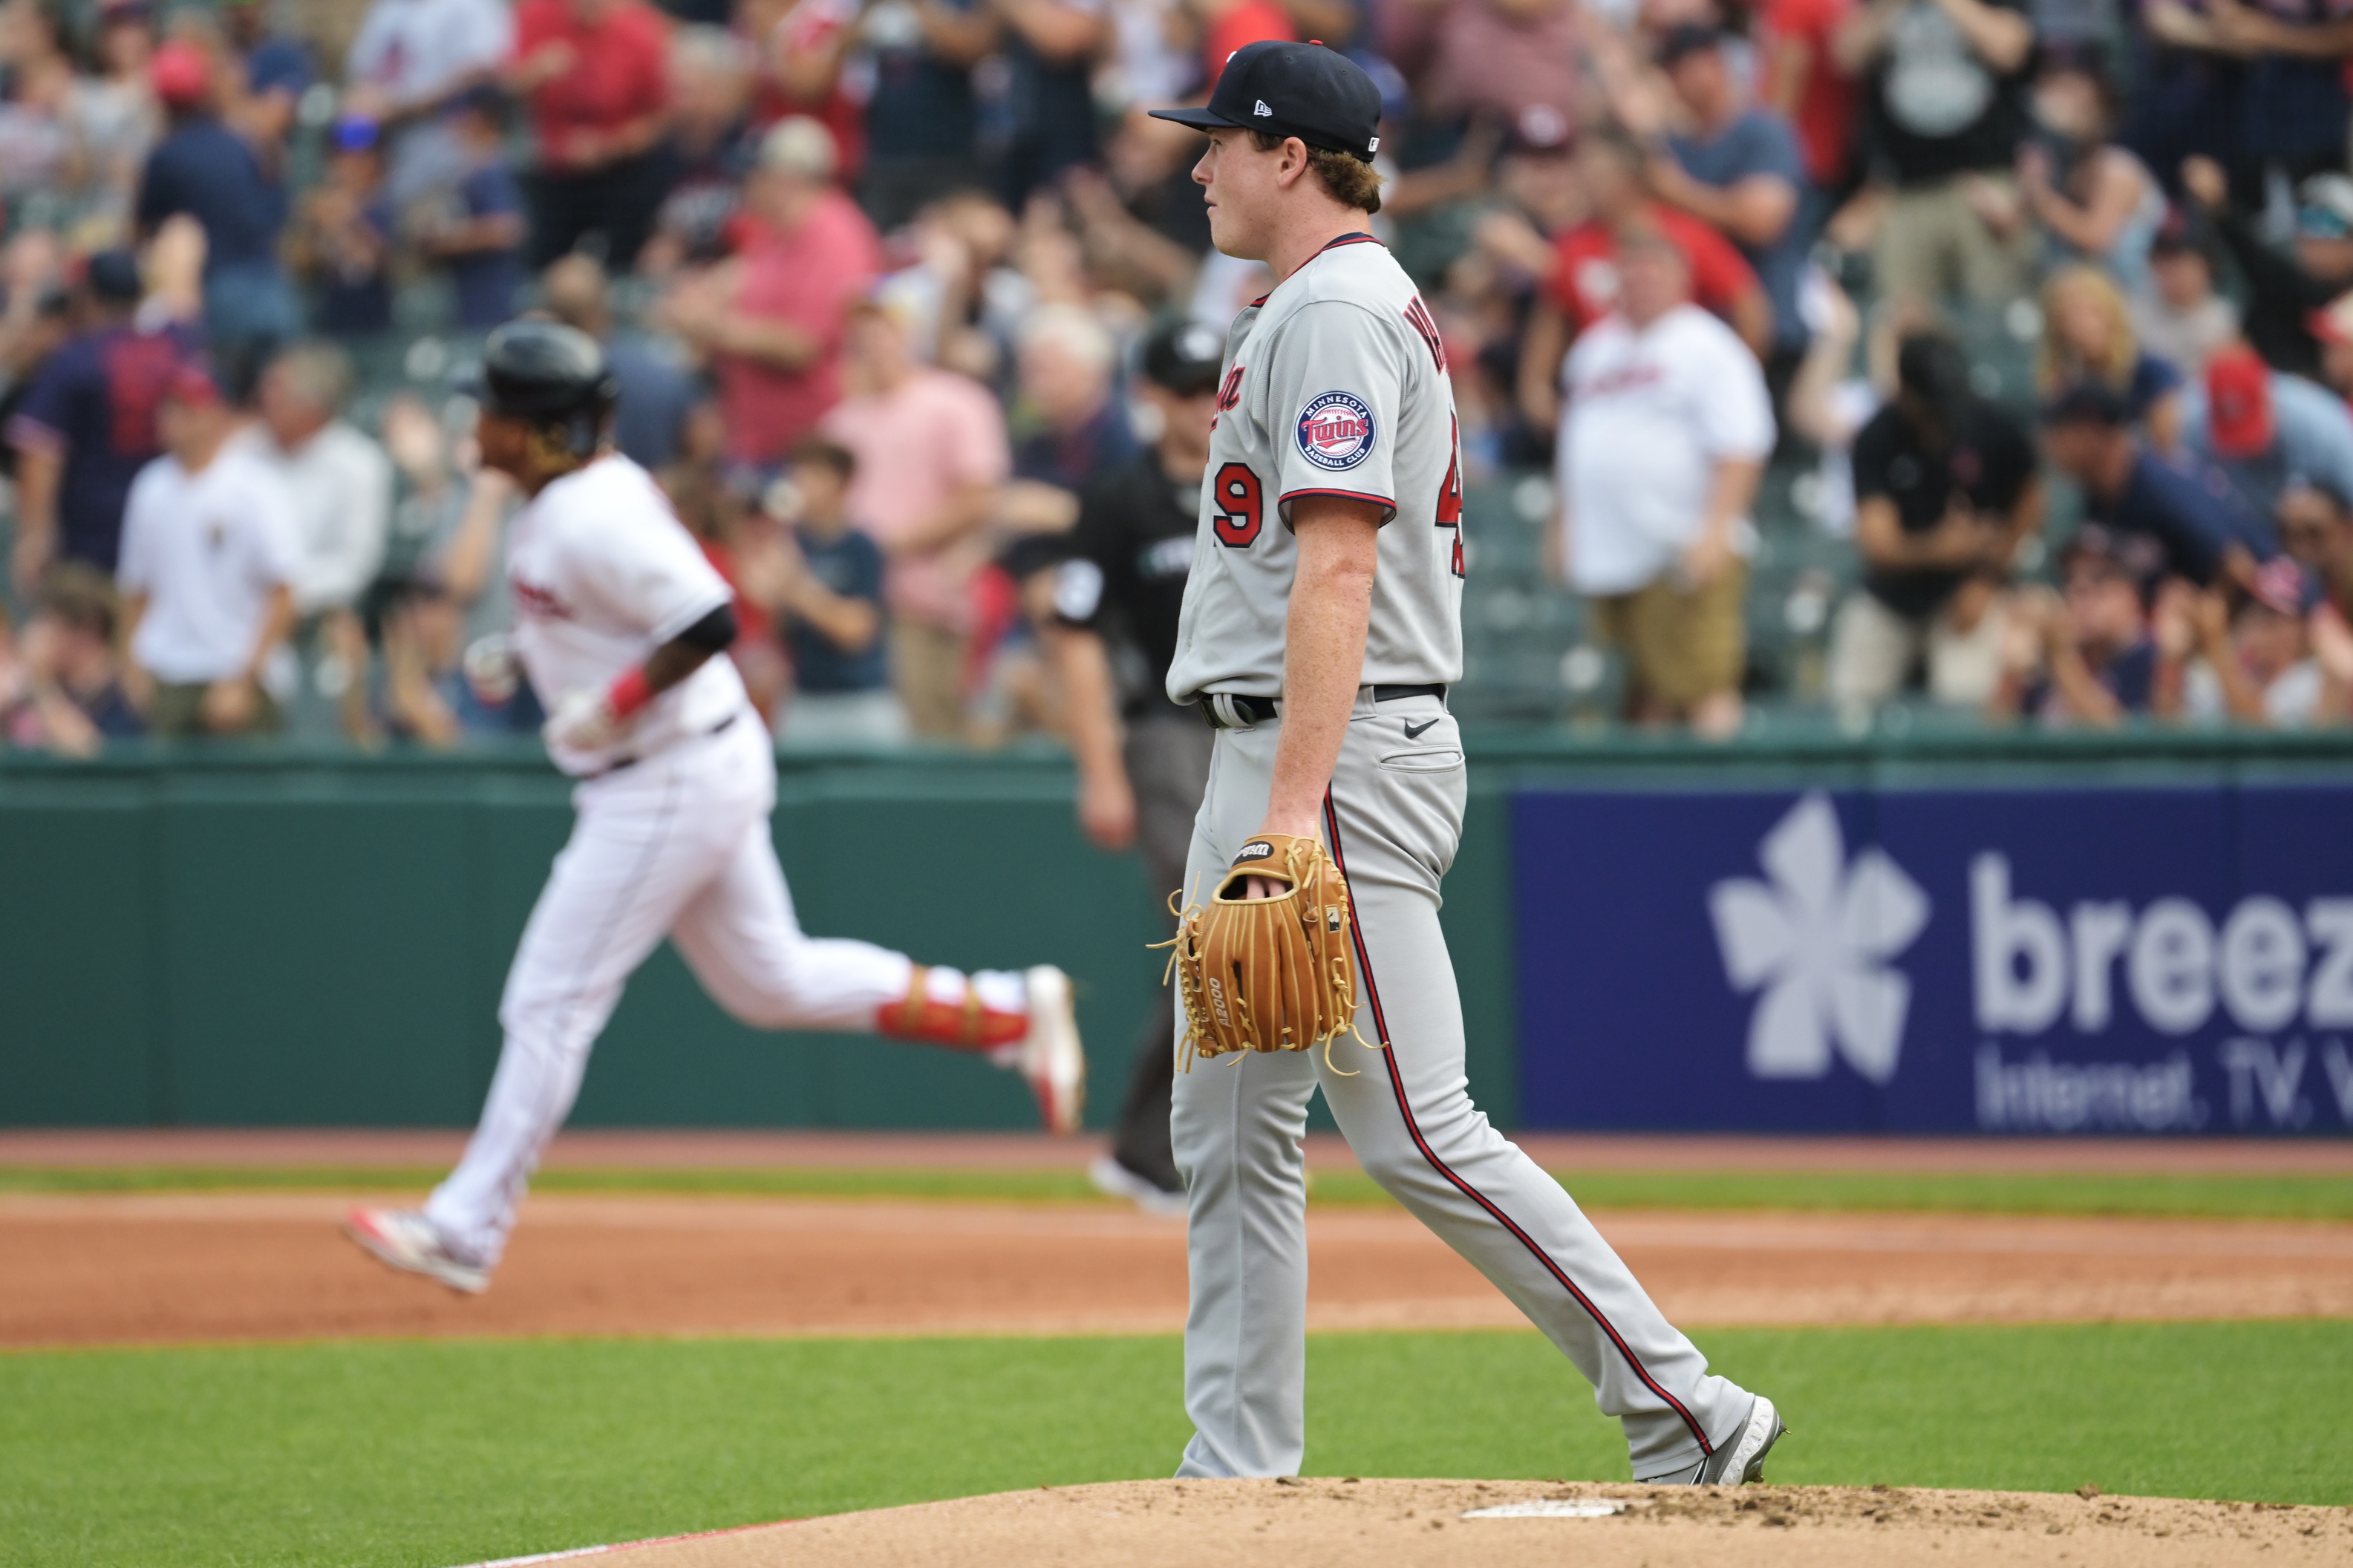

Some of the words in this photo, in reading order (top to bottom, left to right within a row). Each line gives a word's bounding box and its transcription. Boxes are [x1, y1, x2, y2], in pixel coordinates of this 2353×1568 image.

[1305, 396, 1368, 419] MINNESOTA
[1301, 416, 1369, 445] Twins
[1305, 445, 1345, 466] BASEBALL
[1346, 448, 1366, 464] CLUB
[1209, 977, 1233, 1028] A2000
